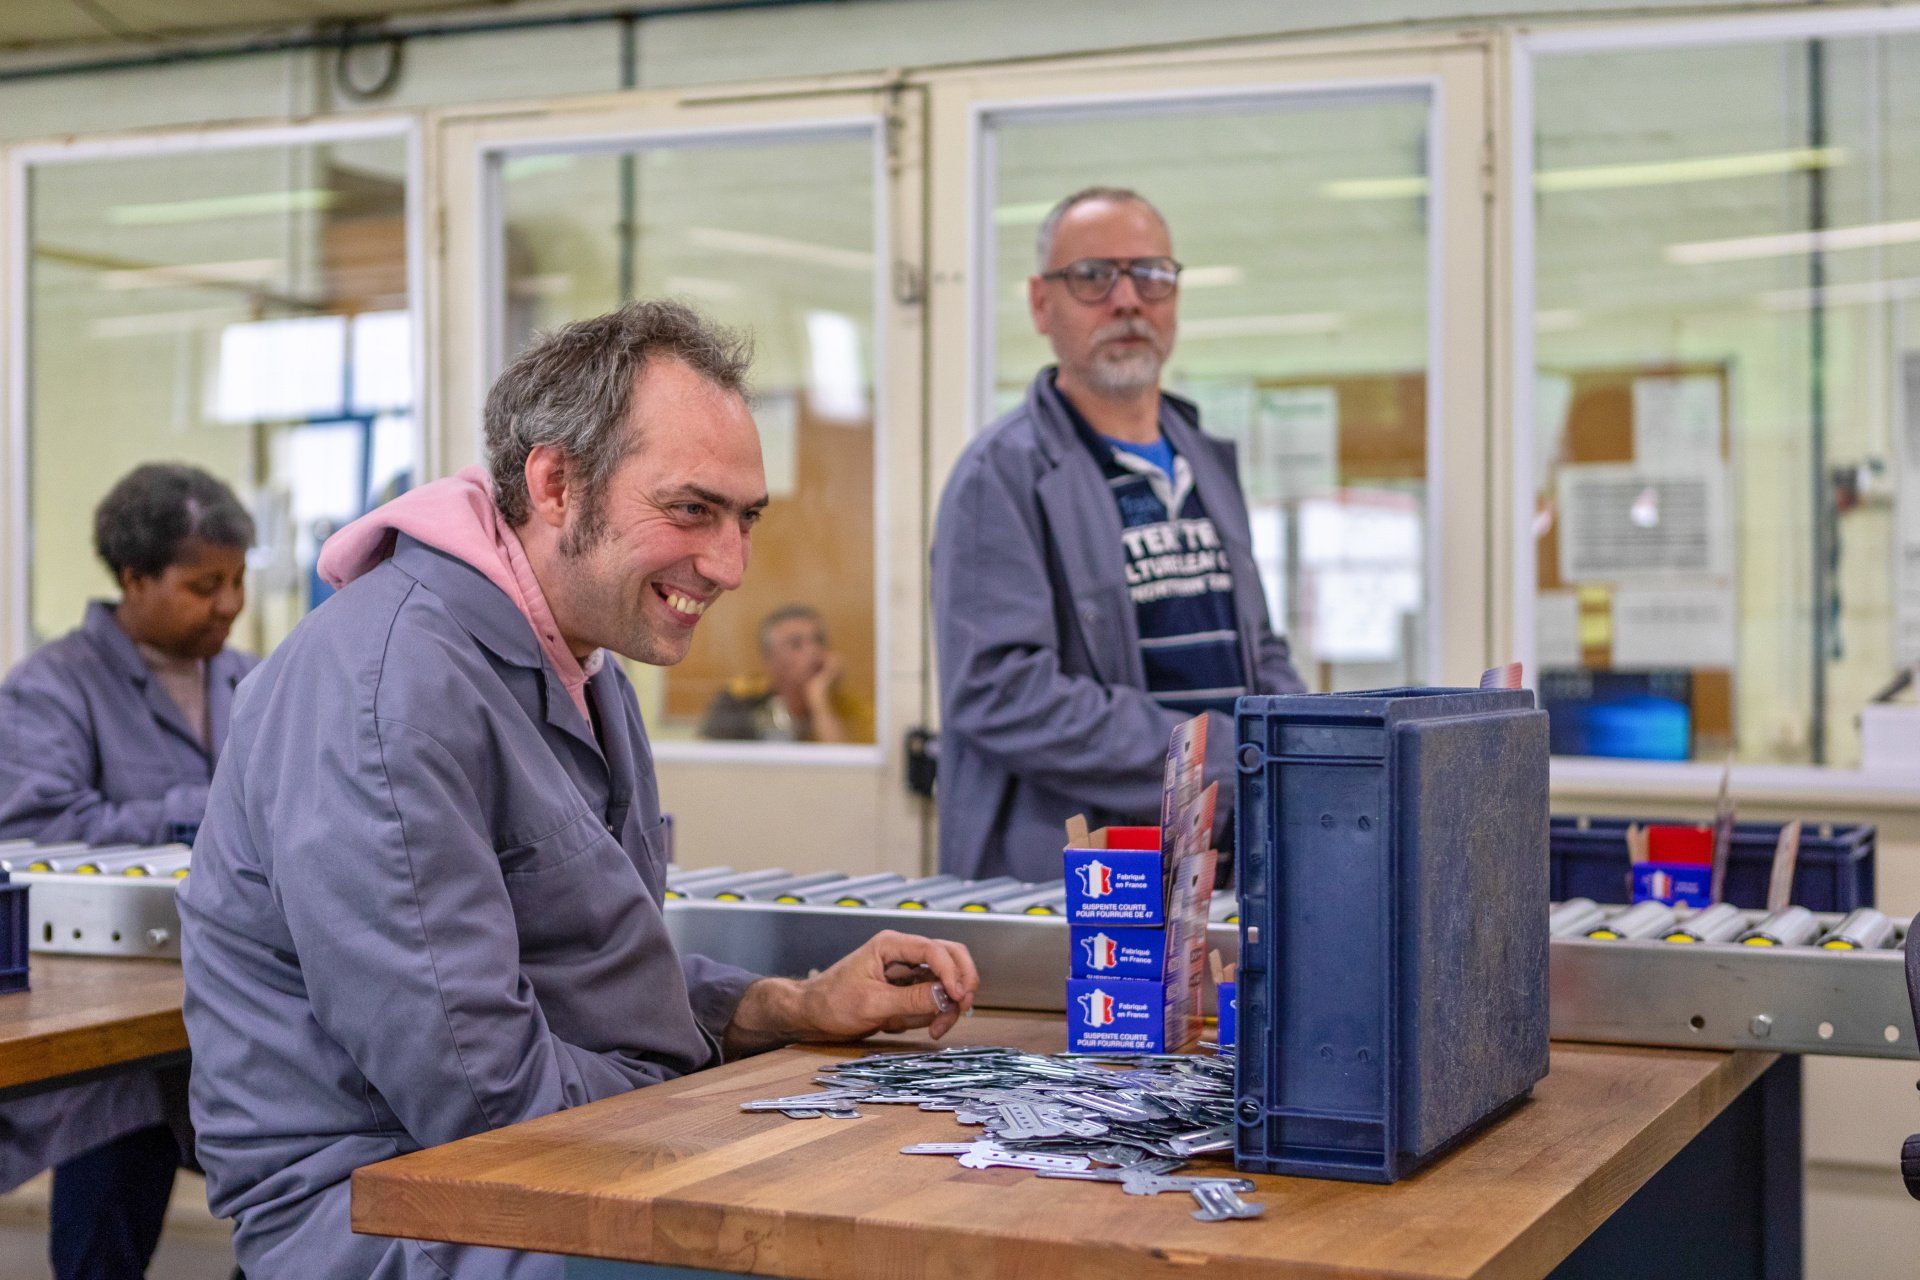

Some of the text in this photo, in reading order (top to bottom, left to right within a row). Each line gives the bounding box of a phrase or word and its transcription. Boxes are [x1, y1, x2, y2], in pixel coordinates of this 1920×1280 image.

[1116, 873, 1146, 882] Fabriqué
[1124, 881, 1148, 889] France
[1081, 903, 1147, 911] SUSPENTE COURTE
[1075, 910, 1095, 918] POUR
[1096, 910, 1133, 918] FOURRURE
[1121, 947, 1151, 956] Fabriqué
[1129, 955, 1152, 964] France
[1118, 1002, 1148, 1011] Fabriqué
[1126, 1011, 1150, 1019] France
[1083, 1032, 1148, 1041] SUSPENTE COURTE
[1076, 1039, 1096, 1047] POUR
[1097, 1039, 1135, 1048] FOURRURE
[1146, 1041, 1155, 1049] 47
